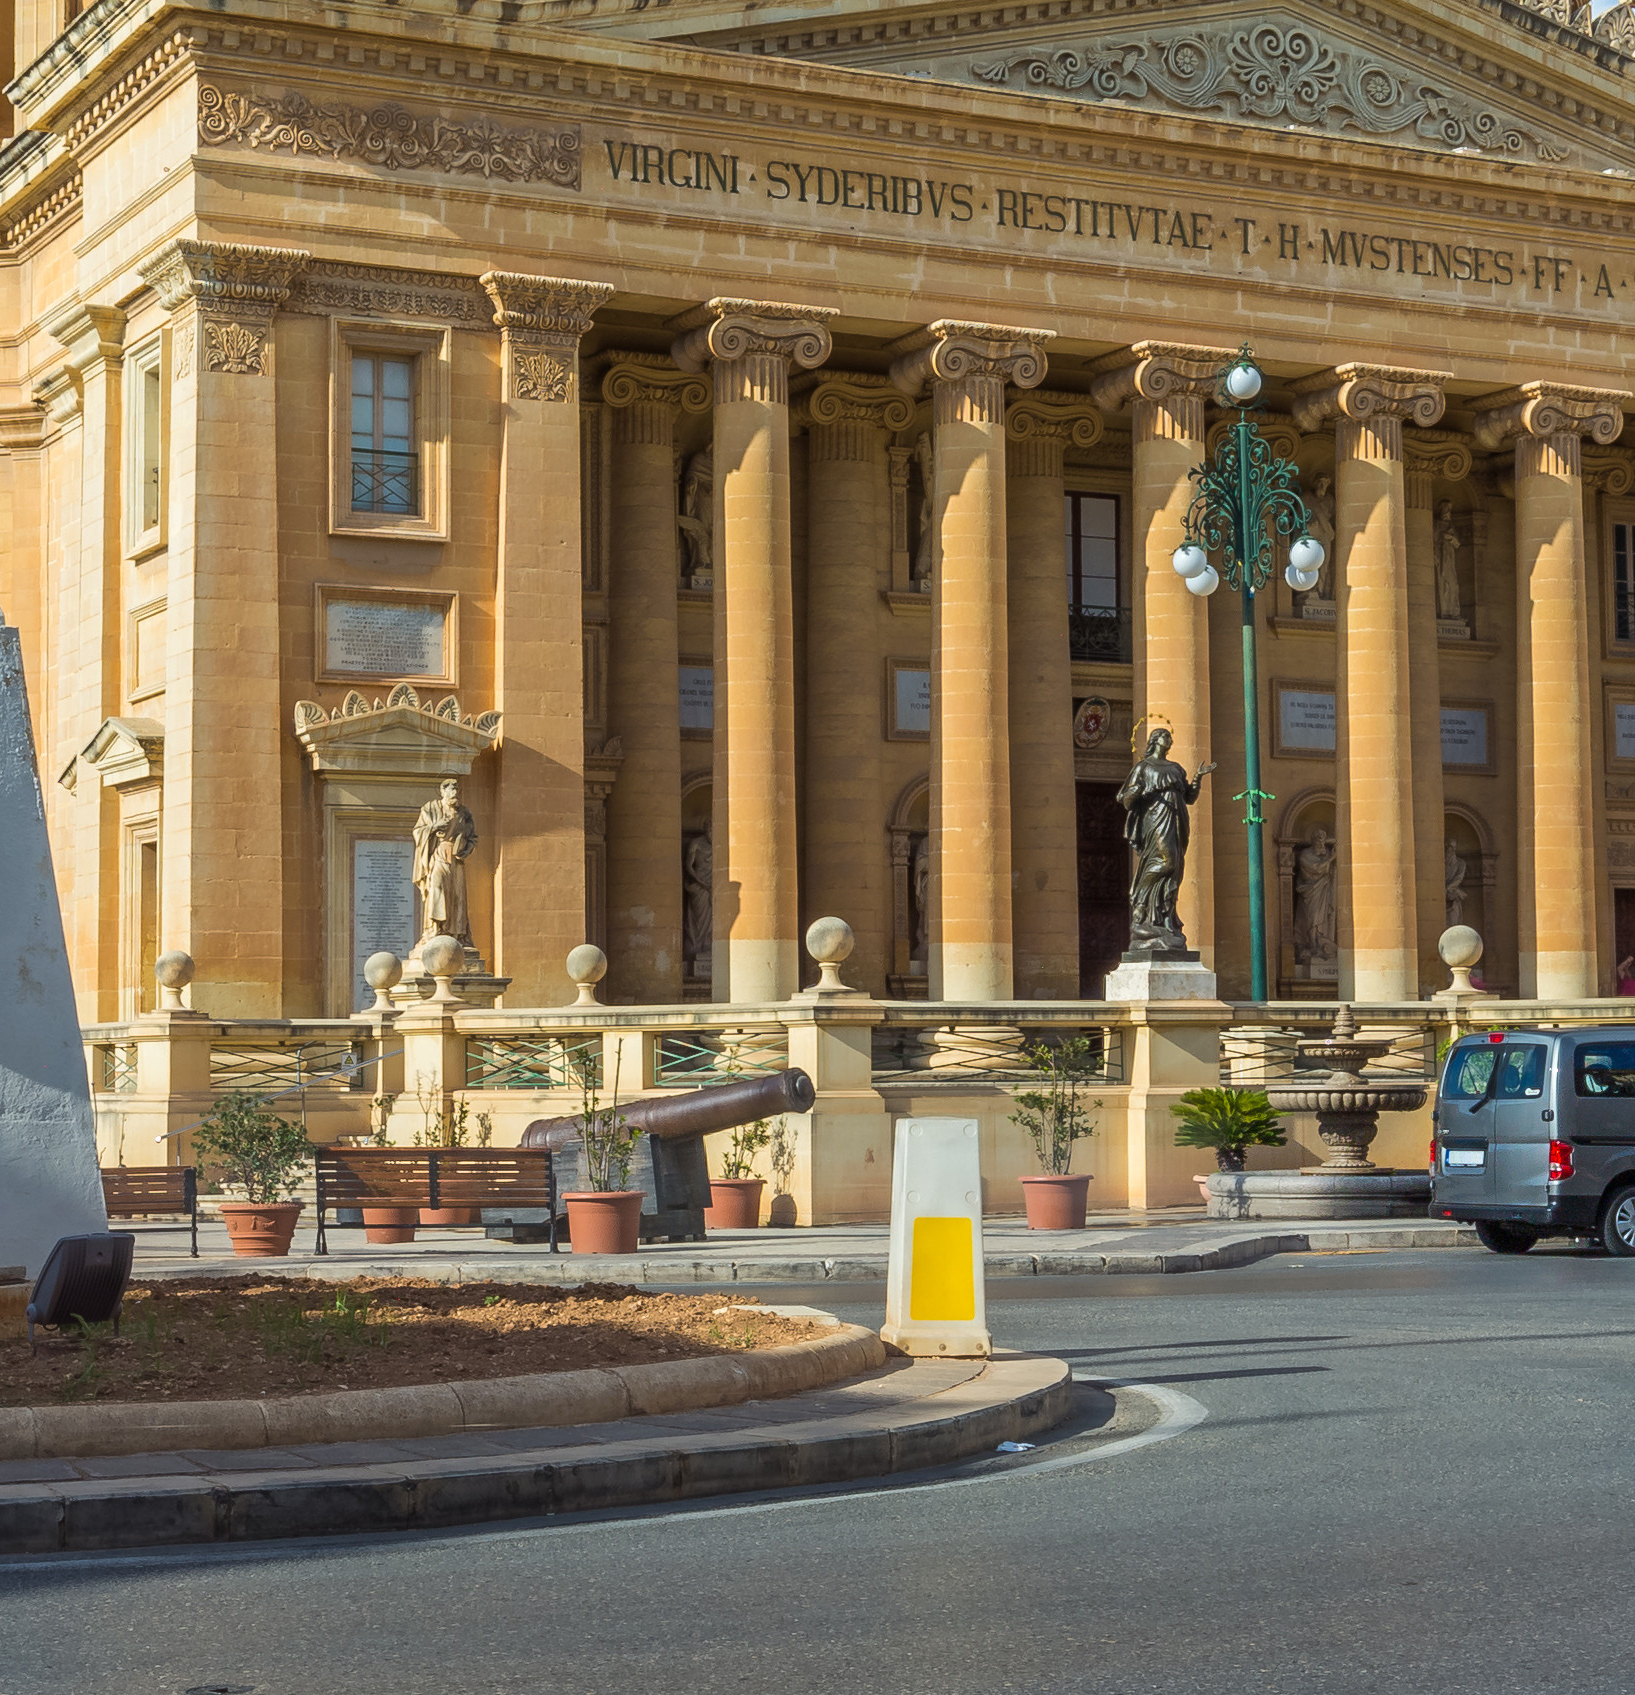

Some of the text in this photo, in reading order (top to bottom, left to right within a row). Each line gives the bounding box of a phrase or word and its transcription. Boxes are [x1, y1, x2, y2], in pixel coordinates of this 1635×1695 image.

[603, 140, 740, 194] VIRGINI
[767, 161, 974, 222] SYDERIBVS
[996, 188, 1213, 250] RESTITVTAE
[1235, 217, 1256, 255] T
[1278, 223, 1300, 261] H
[1321, 228, 1513, 286] MVSTENSES
[1534, 255, 1572, 292] FF
[1594, 264, 1615, 298] A
